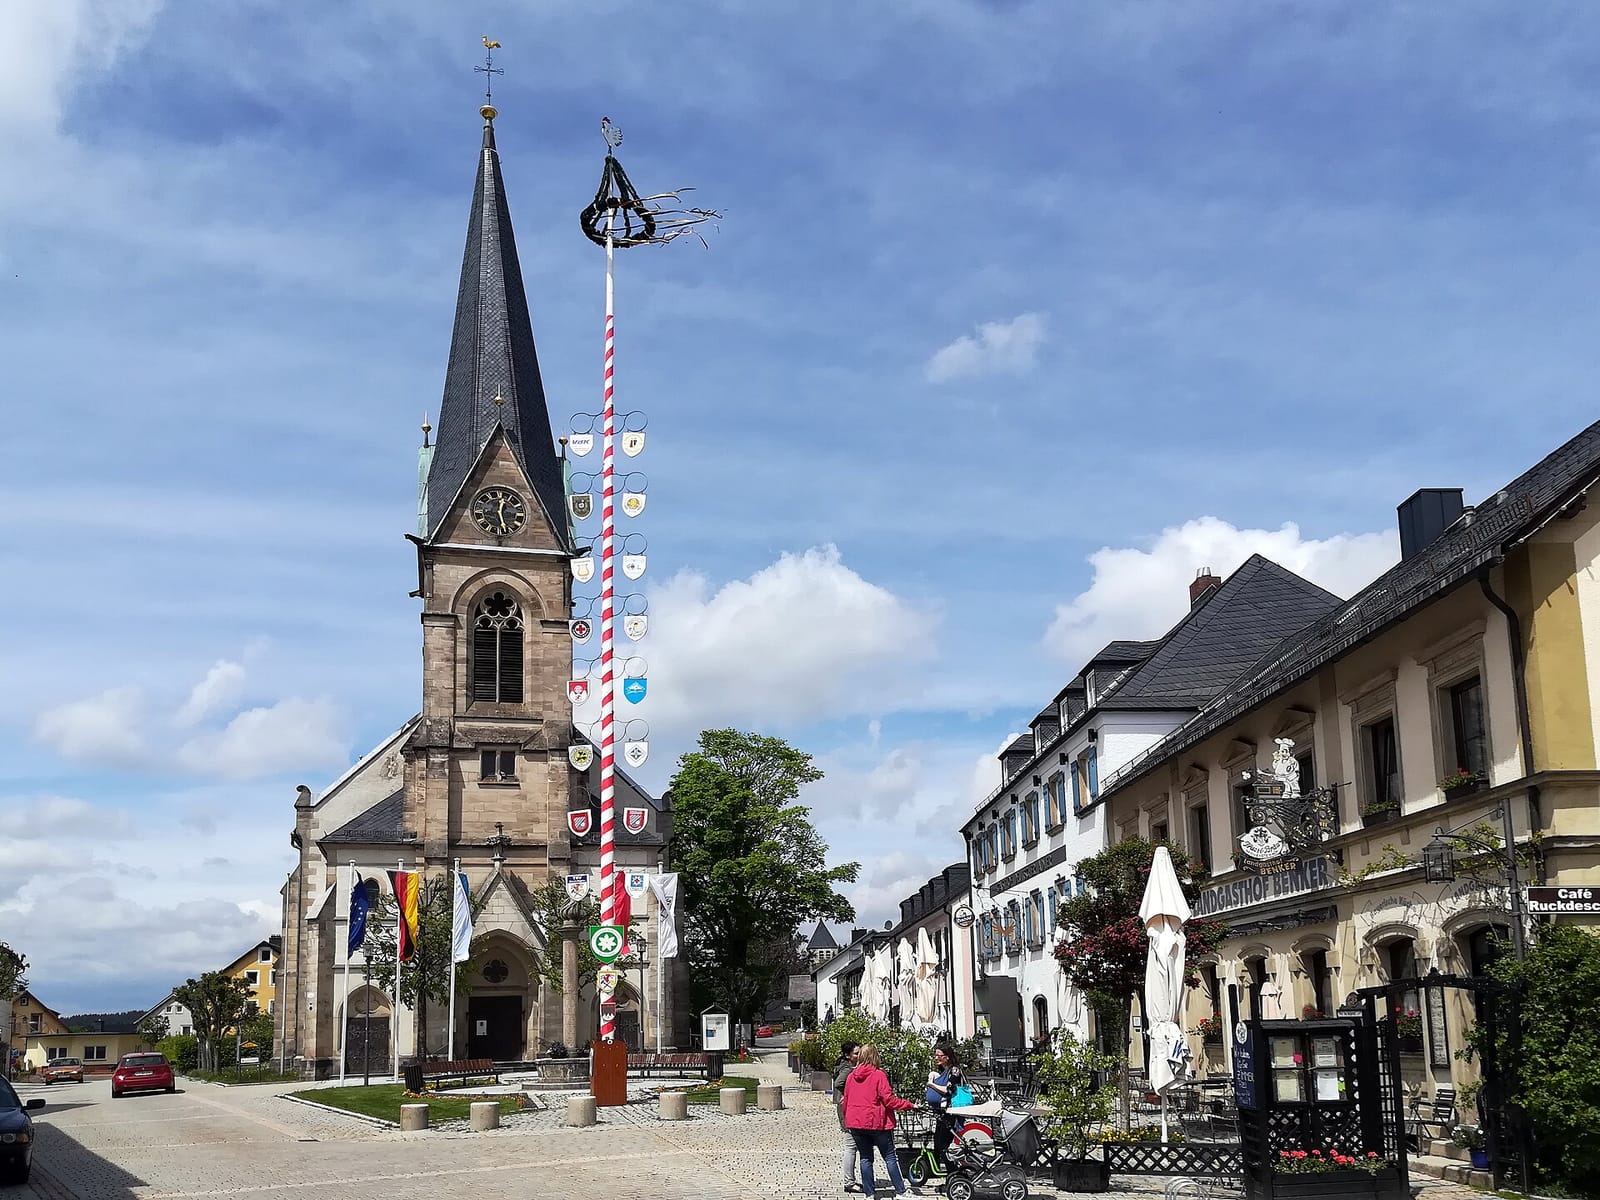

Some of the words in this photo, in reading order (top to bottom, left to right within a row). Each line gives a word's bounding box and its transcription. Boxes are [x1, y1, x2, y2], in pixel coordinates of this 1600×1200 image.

[1260, 862, 1297, 875] BENKER
[1192, 876, 1270, 916] ANDGASTHOF
[1273, 857, 1328, 898] BENKER
[1557, 888, 1593, 899] Café
[1529, 900, 1600, 911] Ruckdesc
